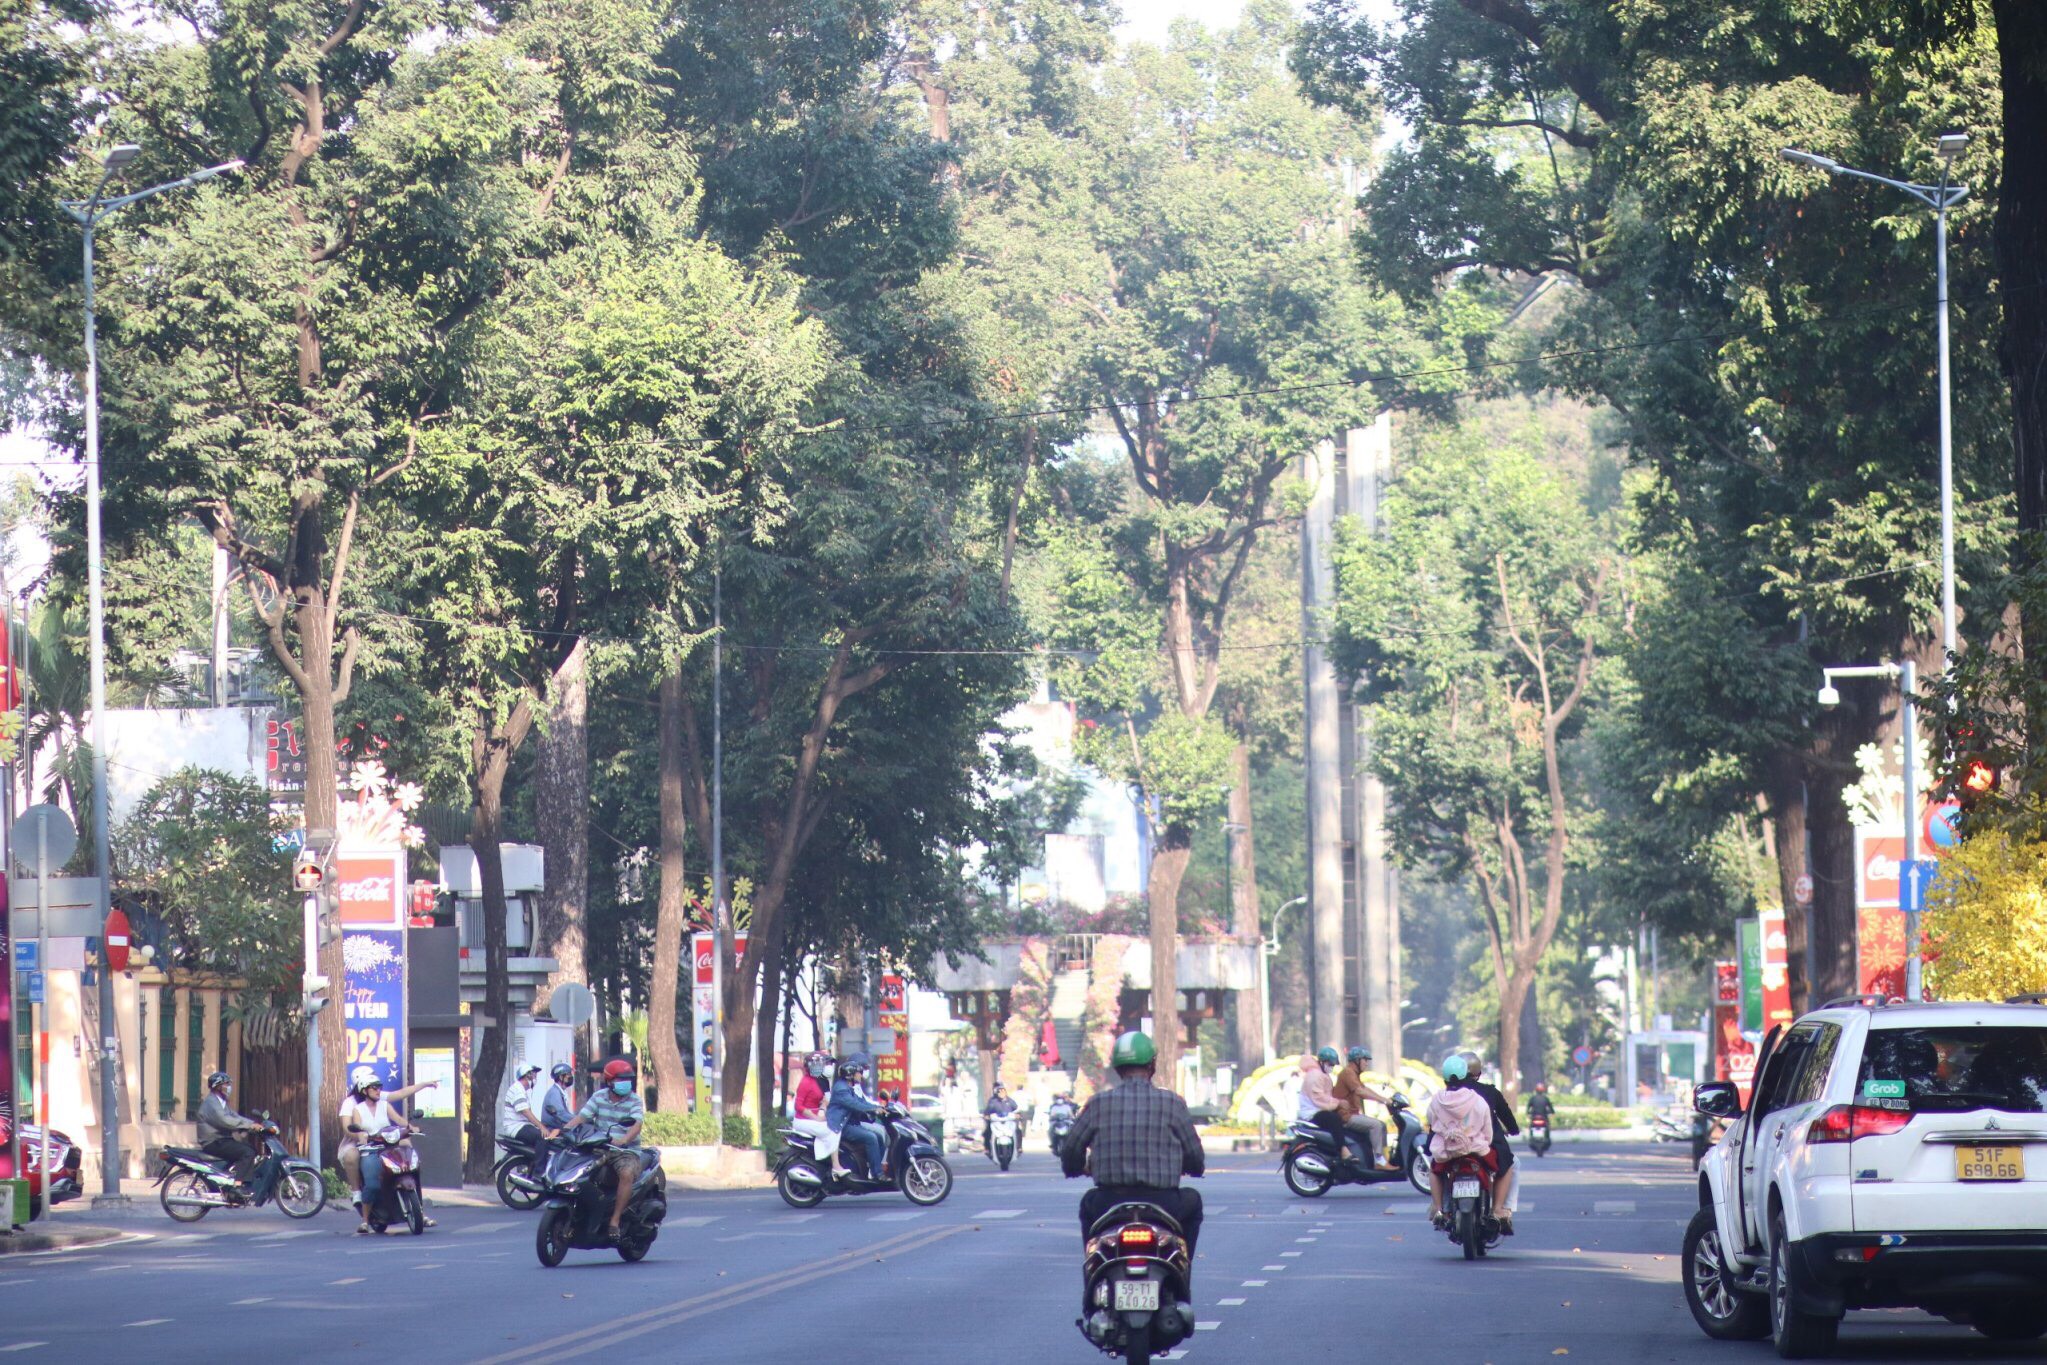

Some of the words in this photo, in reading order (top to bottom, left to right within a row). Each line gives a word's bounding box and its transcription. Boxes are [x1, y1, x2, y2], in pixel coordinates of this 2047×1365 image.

[357, 1002, 388, 1018] YEAR
[346, 1028, 396, 1064] 024
[1870, 1083, 1900, 1094] Grab
[1975, 1149, 2003, 1162] 51F
[1964, 1163, 2017, 1178] 698.66
[1122, 1283, 1150, 1295] 59-T1
